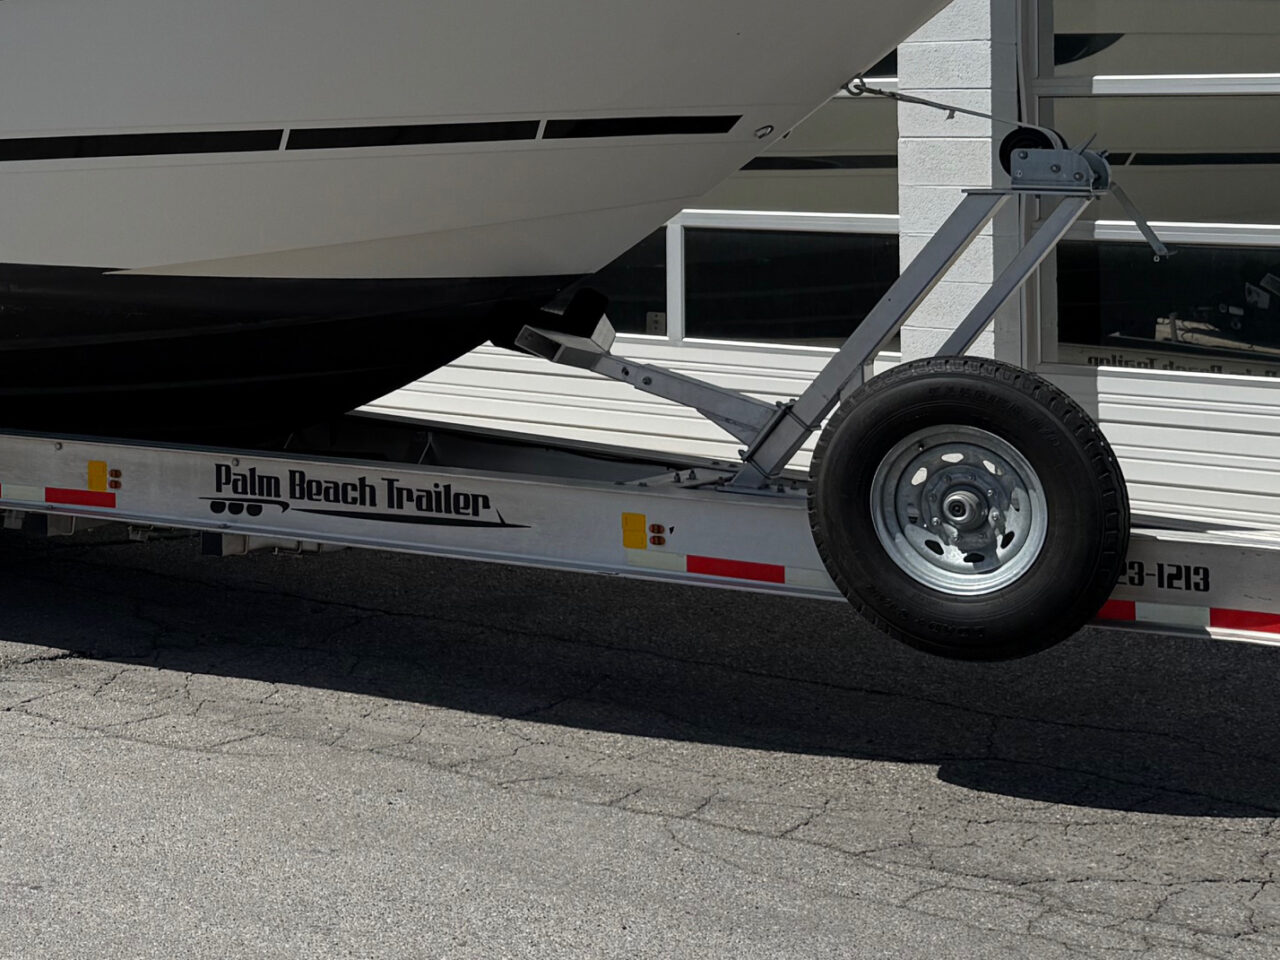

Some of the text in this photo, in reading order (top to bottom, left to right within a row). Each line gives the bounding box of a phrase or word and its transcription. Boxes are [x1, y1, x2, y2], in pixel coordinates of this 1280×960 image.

[214, 463, 491, 517] Palm Beach Trailer
